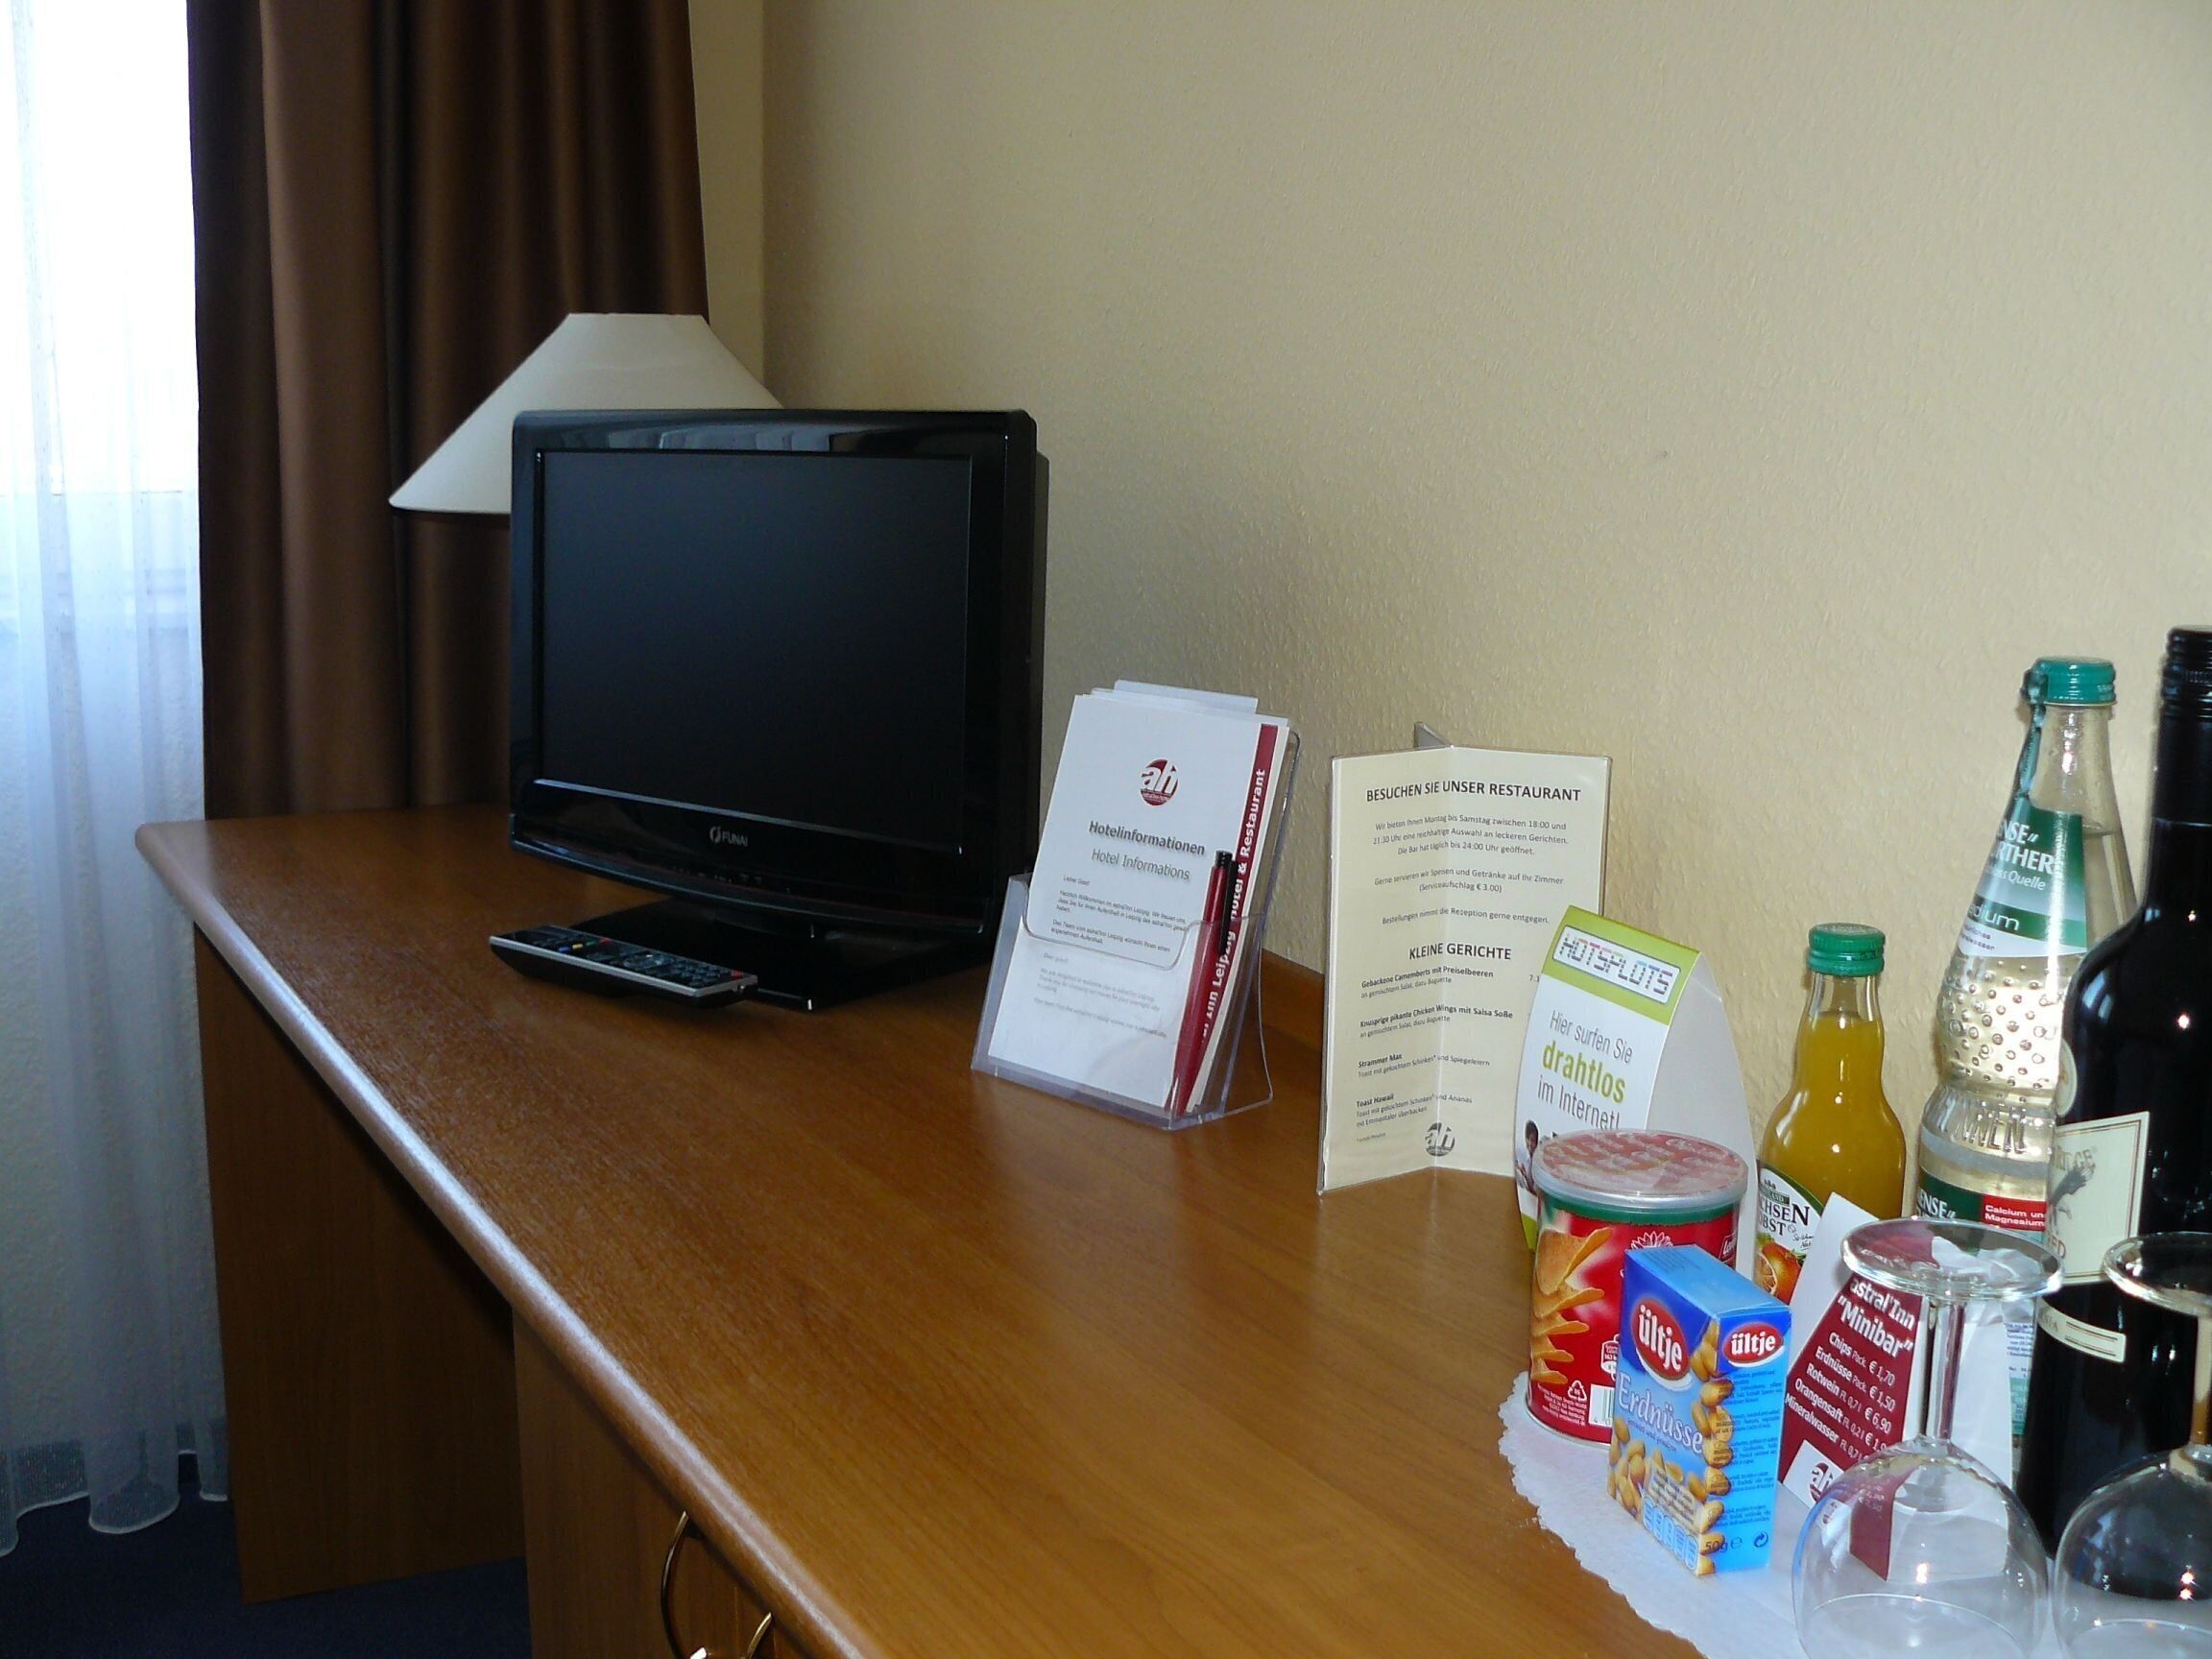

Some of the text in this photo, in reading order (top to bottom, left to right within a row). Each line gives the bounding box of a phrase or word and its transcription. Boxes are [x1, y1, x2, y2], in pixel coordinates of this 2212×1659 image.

[1366, 780, 1581, 802] BESUCHEN SIE UNSER RESTAURANT
[1239, 768, 1265, 858] Restaurant
[1448, 813, 1458, 822] bis
[1459, 814, 1491, 826] Samstag
[1492, 817, 1527, 828] zwischen
[1551, 822, 1567, 830] und
[722, 830, 749, 847] FUNAI
[1089, 820, 1206, 856] Hotelinformationen
[1451, 827, 1482, 837] Auswahl
[1495, 830, 1527, 841] leckeren
[1528, 833, 1569, 845] Gerichten.
[1408, 845, 1419, 854] Bar
[1419, 843, 1430, 852] hat
[1450, 840, 1461, 849] bis
[1485, 844, 1499, 853] Uhr
[1501, 845, 1535, 855] geöffnet.
[1091, 848, 1191, 882] Hotel Informations
[1238, 862, 1248, 876] &
[1455, 868, 1471, 877] und
[1471, 869, 1506, 880] Getränke
[1507, 873, 1521, 881] auf
[1522, 873, 1532, 882] Ihr
[1533, 875, 1564, 885] Zimmer
[2008, 870, 2047, 891] Quelle
[1451, 907, 1488, 918] Rezeption
[1488, 911, 1511, 921] gerne
[1408, 942, 1512, 960] KLEINE GERICHTE
[1431, 966, 1442, 974] mit
[1442, 965, 1494, 979] Preiselbeeren
[1412, 1006, 1435, 1018] Chicken
[1435, 1003, 1457, 1014] Wings
[1458, 1005, 1472, 1015] mit
[1473, 1007, 1493, 1017] Salsa
[1549, 1008, 1633, 1065] Hier surfen Sie
[1358, 1055, 1388, 1069] Strammer
[1542, 1040, 1626, 1104] drahtlos
[1536, 1073, 1621, 1131] im Internet!
[1984, 1204, 2028, 1217] Calcium
[1984, 1213, 2045, 1227] Magnesium
[1637, 1304, 1683, 1373] ültje
[1731, 1331, 1776, 1356] ültje
[1829, 1332, 1852, 1356] Chips
[1868, 1359, 1878, 1375] €
[1878, 1365, 1896, 1387] 1,70
[1815, 1345, 1853, 1381] Erdnüsse
[1869, 1385, 1878, 1400] €
[1877, 1390, 1896, 1412] 1,50
[1806, 1362, 1840, 1397] Rotwein
[1864, 1407, 1873, 1421] €
[1872, 1411, 1892, 1434] 6,90
[1618, 1371, 1703, 1455] Erdnüsse
[1785, 1392, 1839, 1443] Mineralwasser
[1794, 1377, 1843, 1424] Orangensaft
[1864, 1431, 1873, 1446] €
